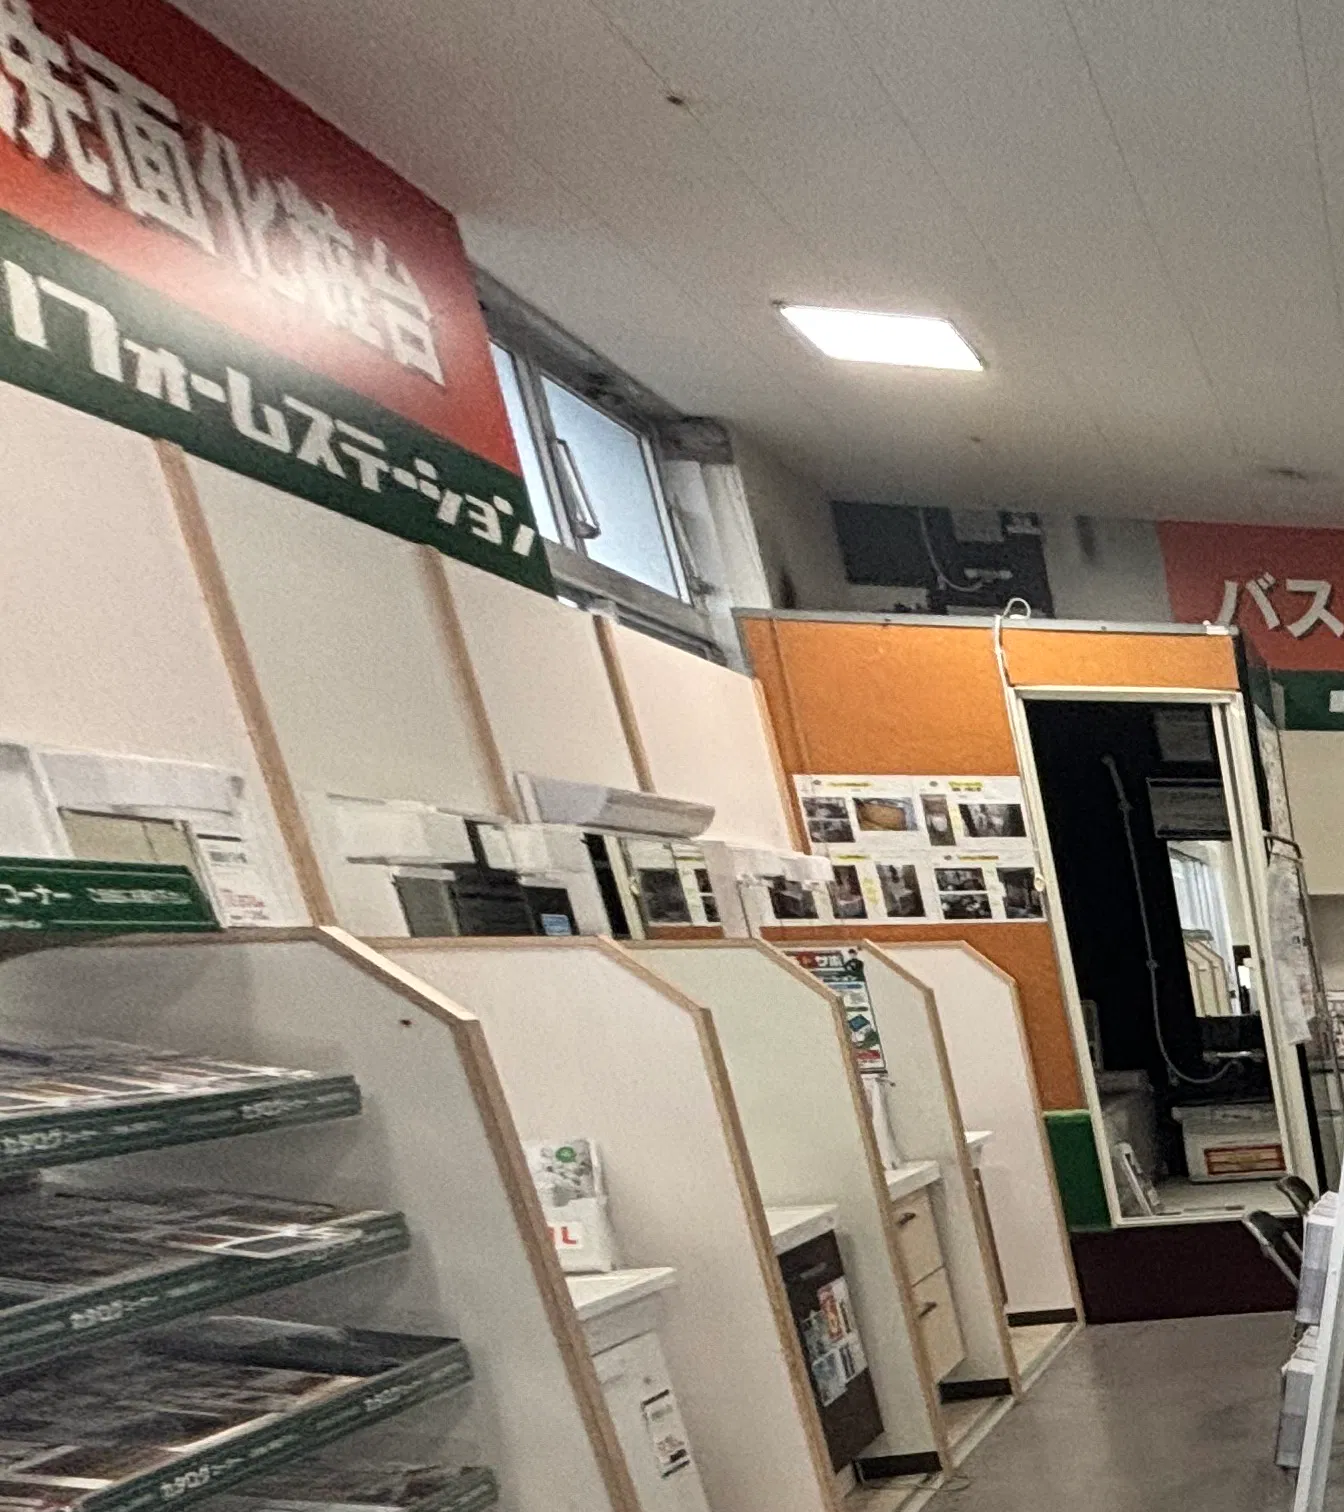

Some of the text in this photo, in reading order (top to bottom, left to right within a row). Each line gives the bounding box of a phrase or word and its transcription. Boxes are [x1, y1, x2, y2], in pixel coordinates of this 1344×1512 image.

[2, 258, 535, 556] リフォームステーション
